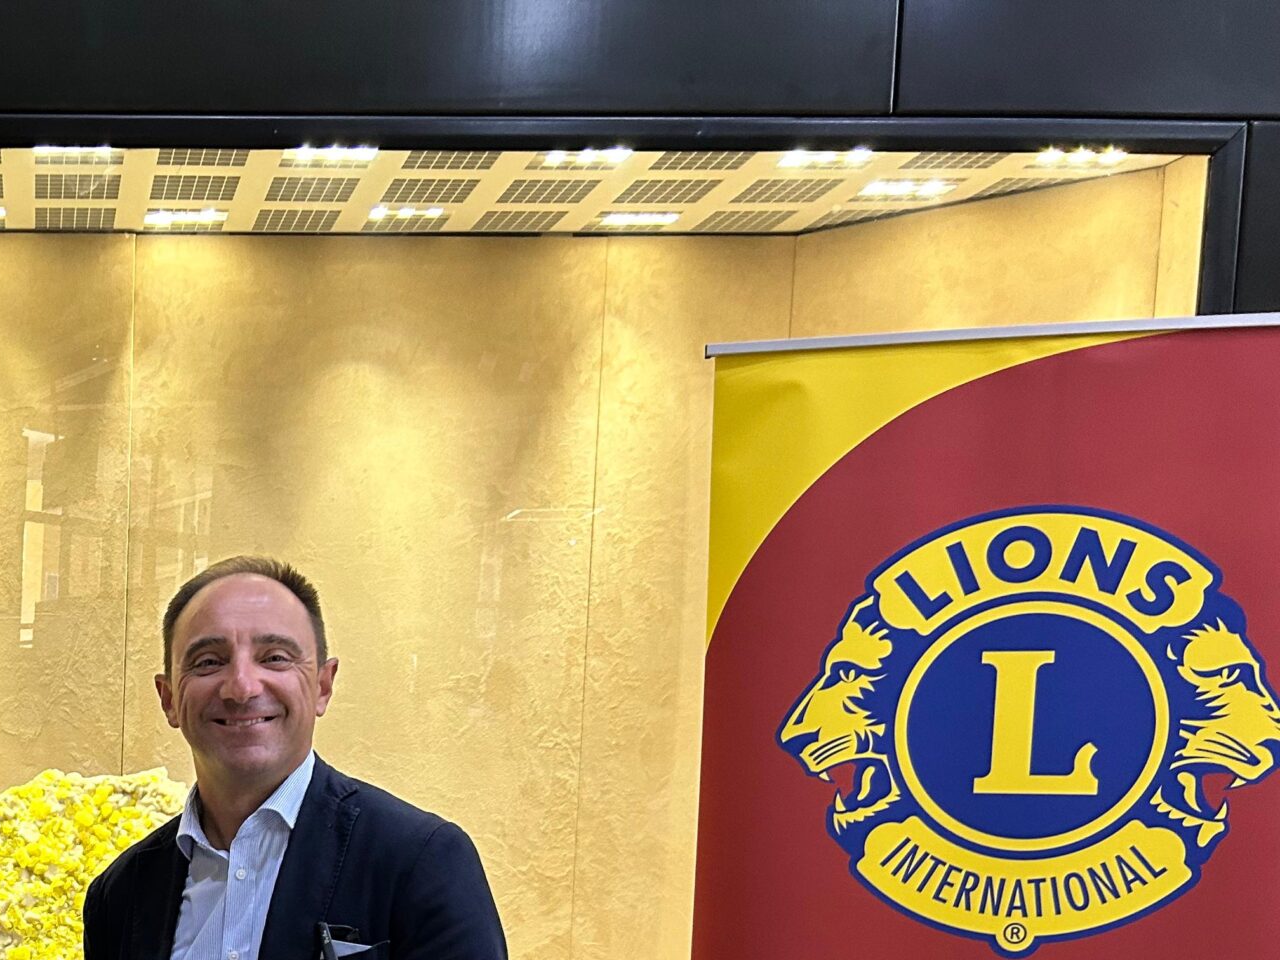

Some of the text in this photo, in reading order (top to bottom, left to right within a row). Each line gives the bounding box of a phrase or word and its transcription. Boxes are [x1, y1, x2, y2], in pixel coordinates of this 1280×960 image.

[894, 525, 1192, 621] LIONS
[973, 650, 1099, 795] L
[880, 836, 1168, 919] INTERNATIONAL
